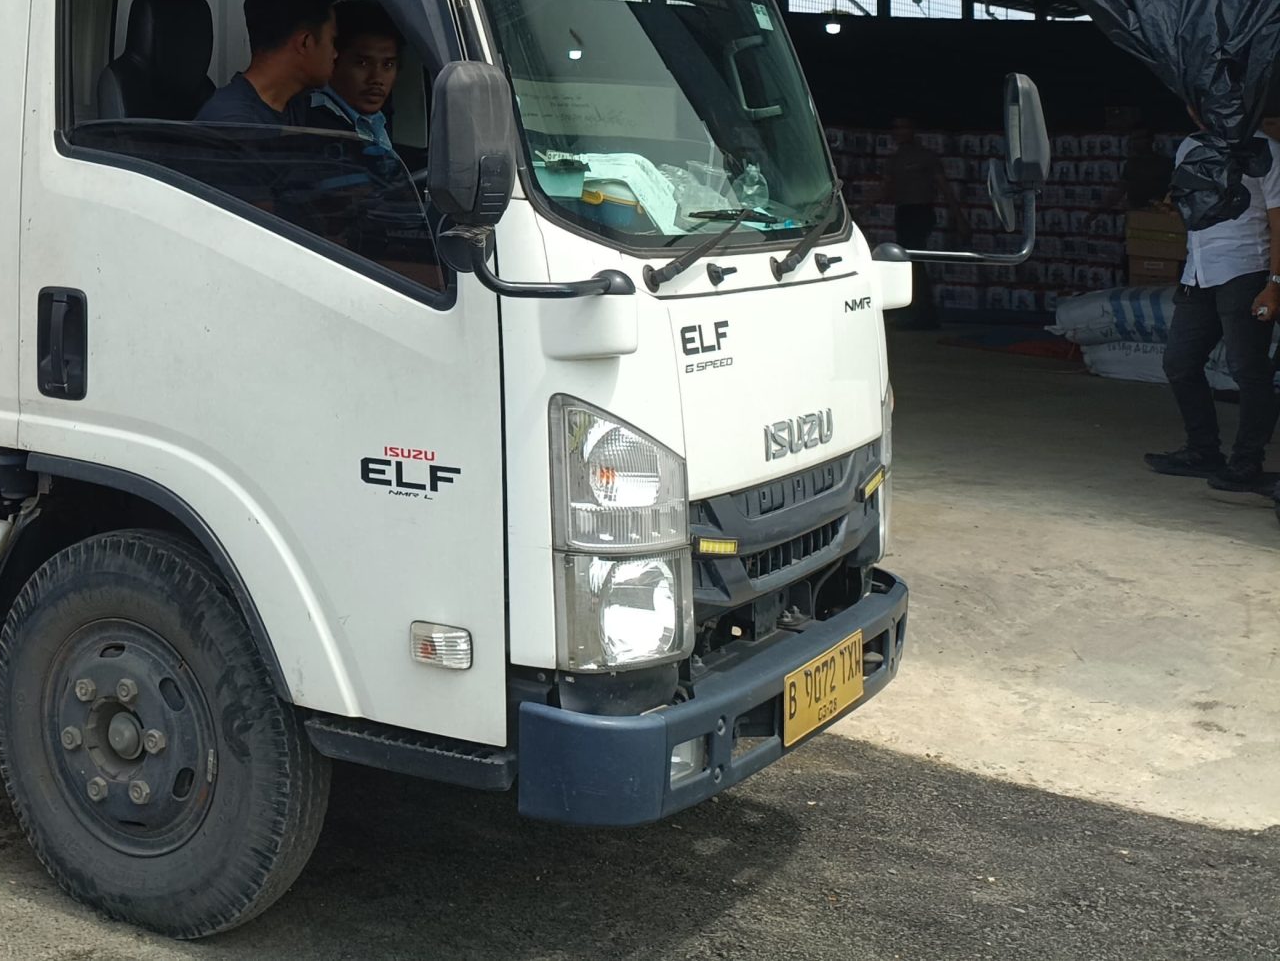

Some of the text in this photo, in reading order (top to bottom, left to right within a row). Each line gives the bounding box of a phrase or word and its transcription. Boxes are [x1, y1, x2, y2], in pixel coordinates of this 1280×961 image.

[844, 296, 872, 313] NMR
[680, 320, 729, 356] ELF
[696, 357, 733, 372] SPEED
[763, 407, 833, 462] ISUZU
[384, 446, 435, 461] ISUZU
[360, 457, 462, 492] ELF
[789, 680, 797, 720] B
[804, 656, 836, 708] 9072
